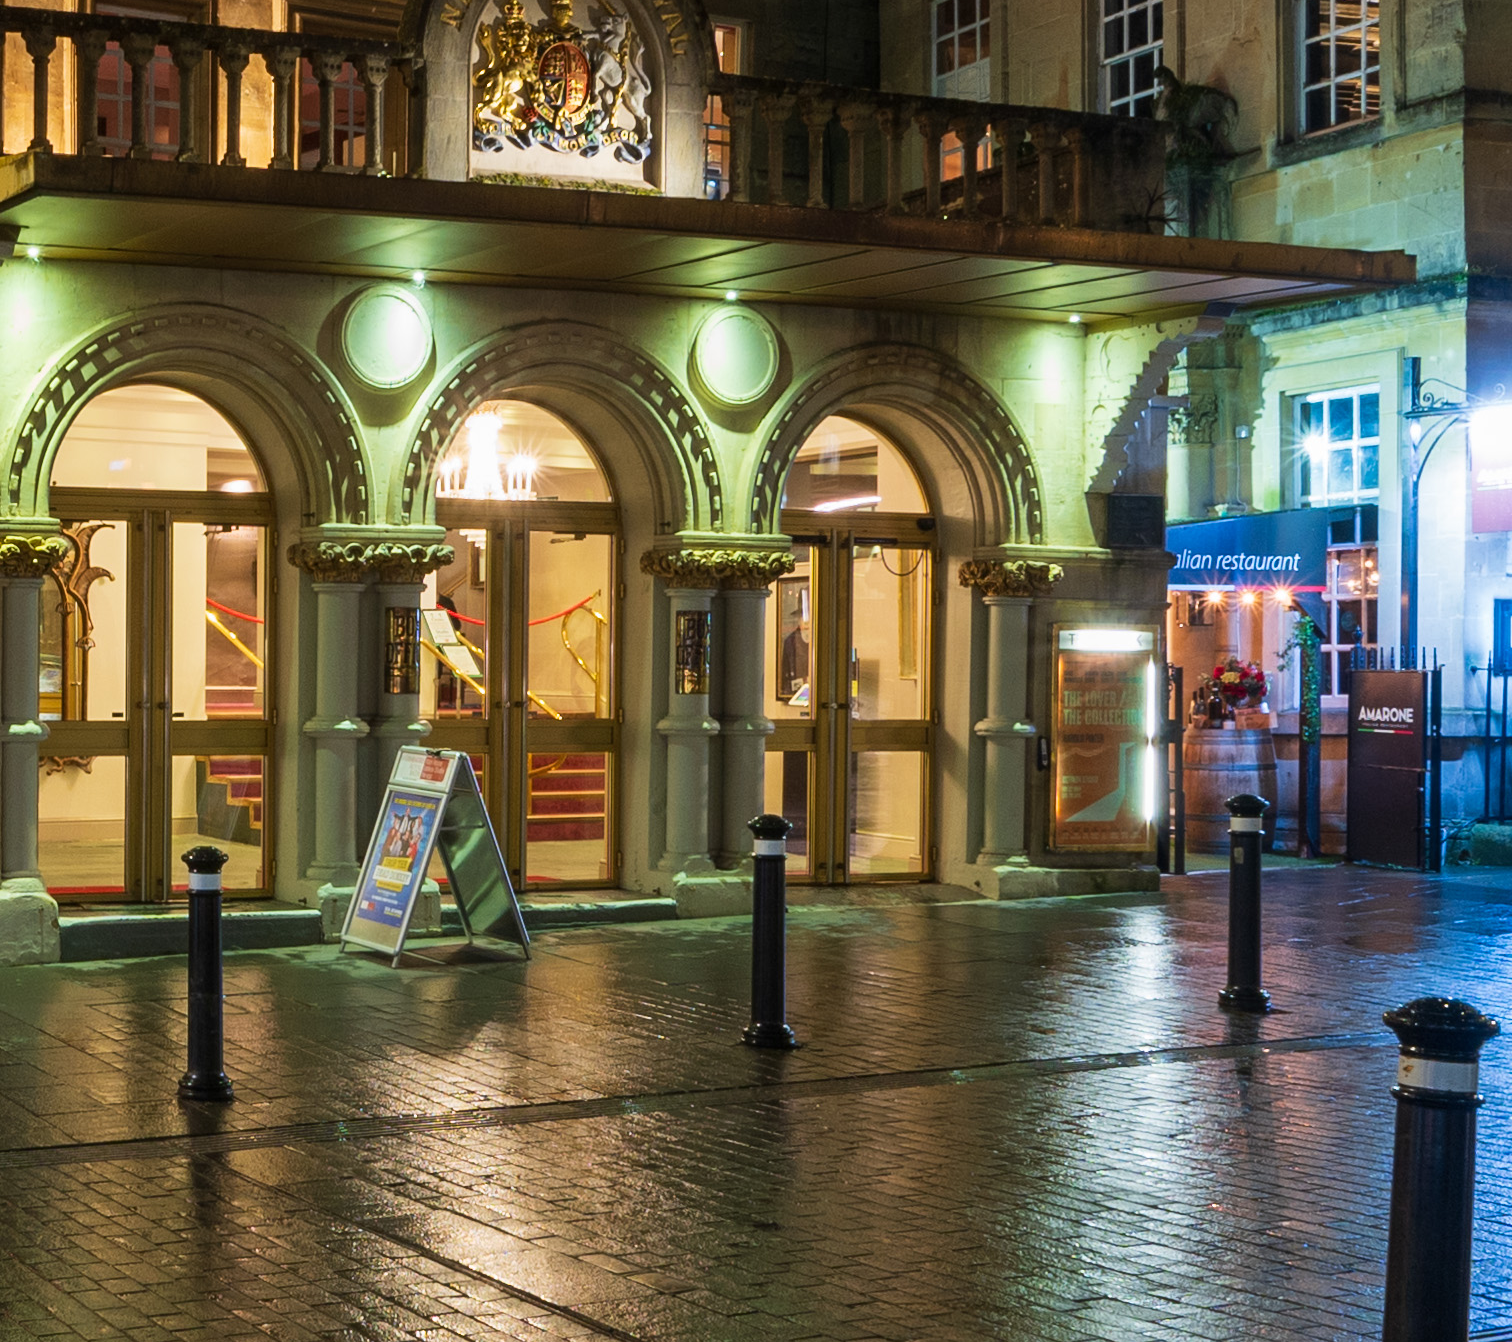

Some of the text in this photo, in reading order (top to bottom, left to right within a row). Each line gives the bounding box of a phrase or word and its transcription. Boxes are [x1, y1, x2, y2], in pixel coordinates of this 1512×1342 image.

[1215, 552, 1302, 571] restaurant
[1064, 690, 1082, 707] THE
[1085, 690, 1117, 707] LOVER
[1064, 708, 1082, 725] THE
[1358, 705, 1414, 723] AMARONE
